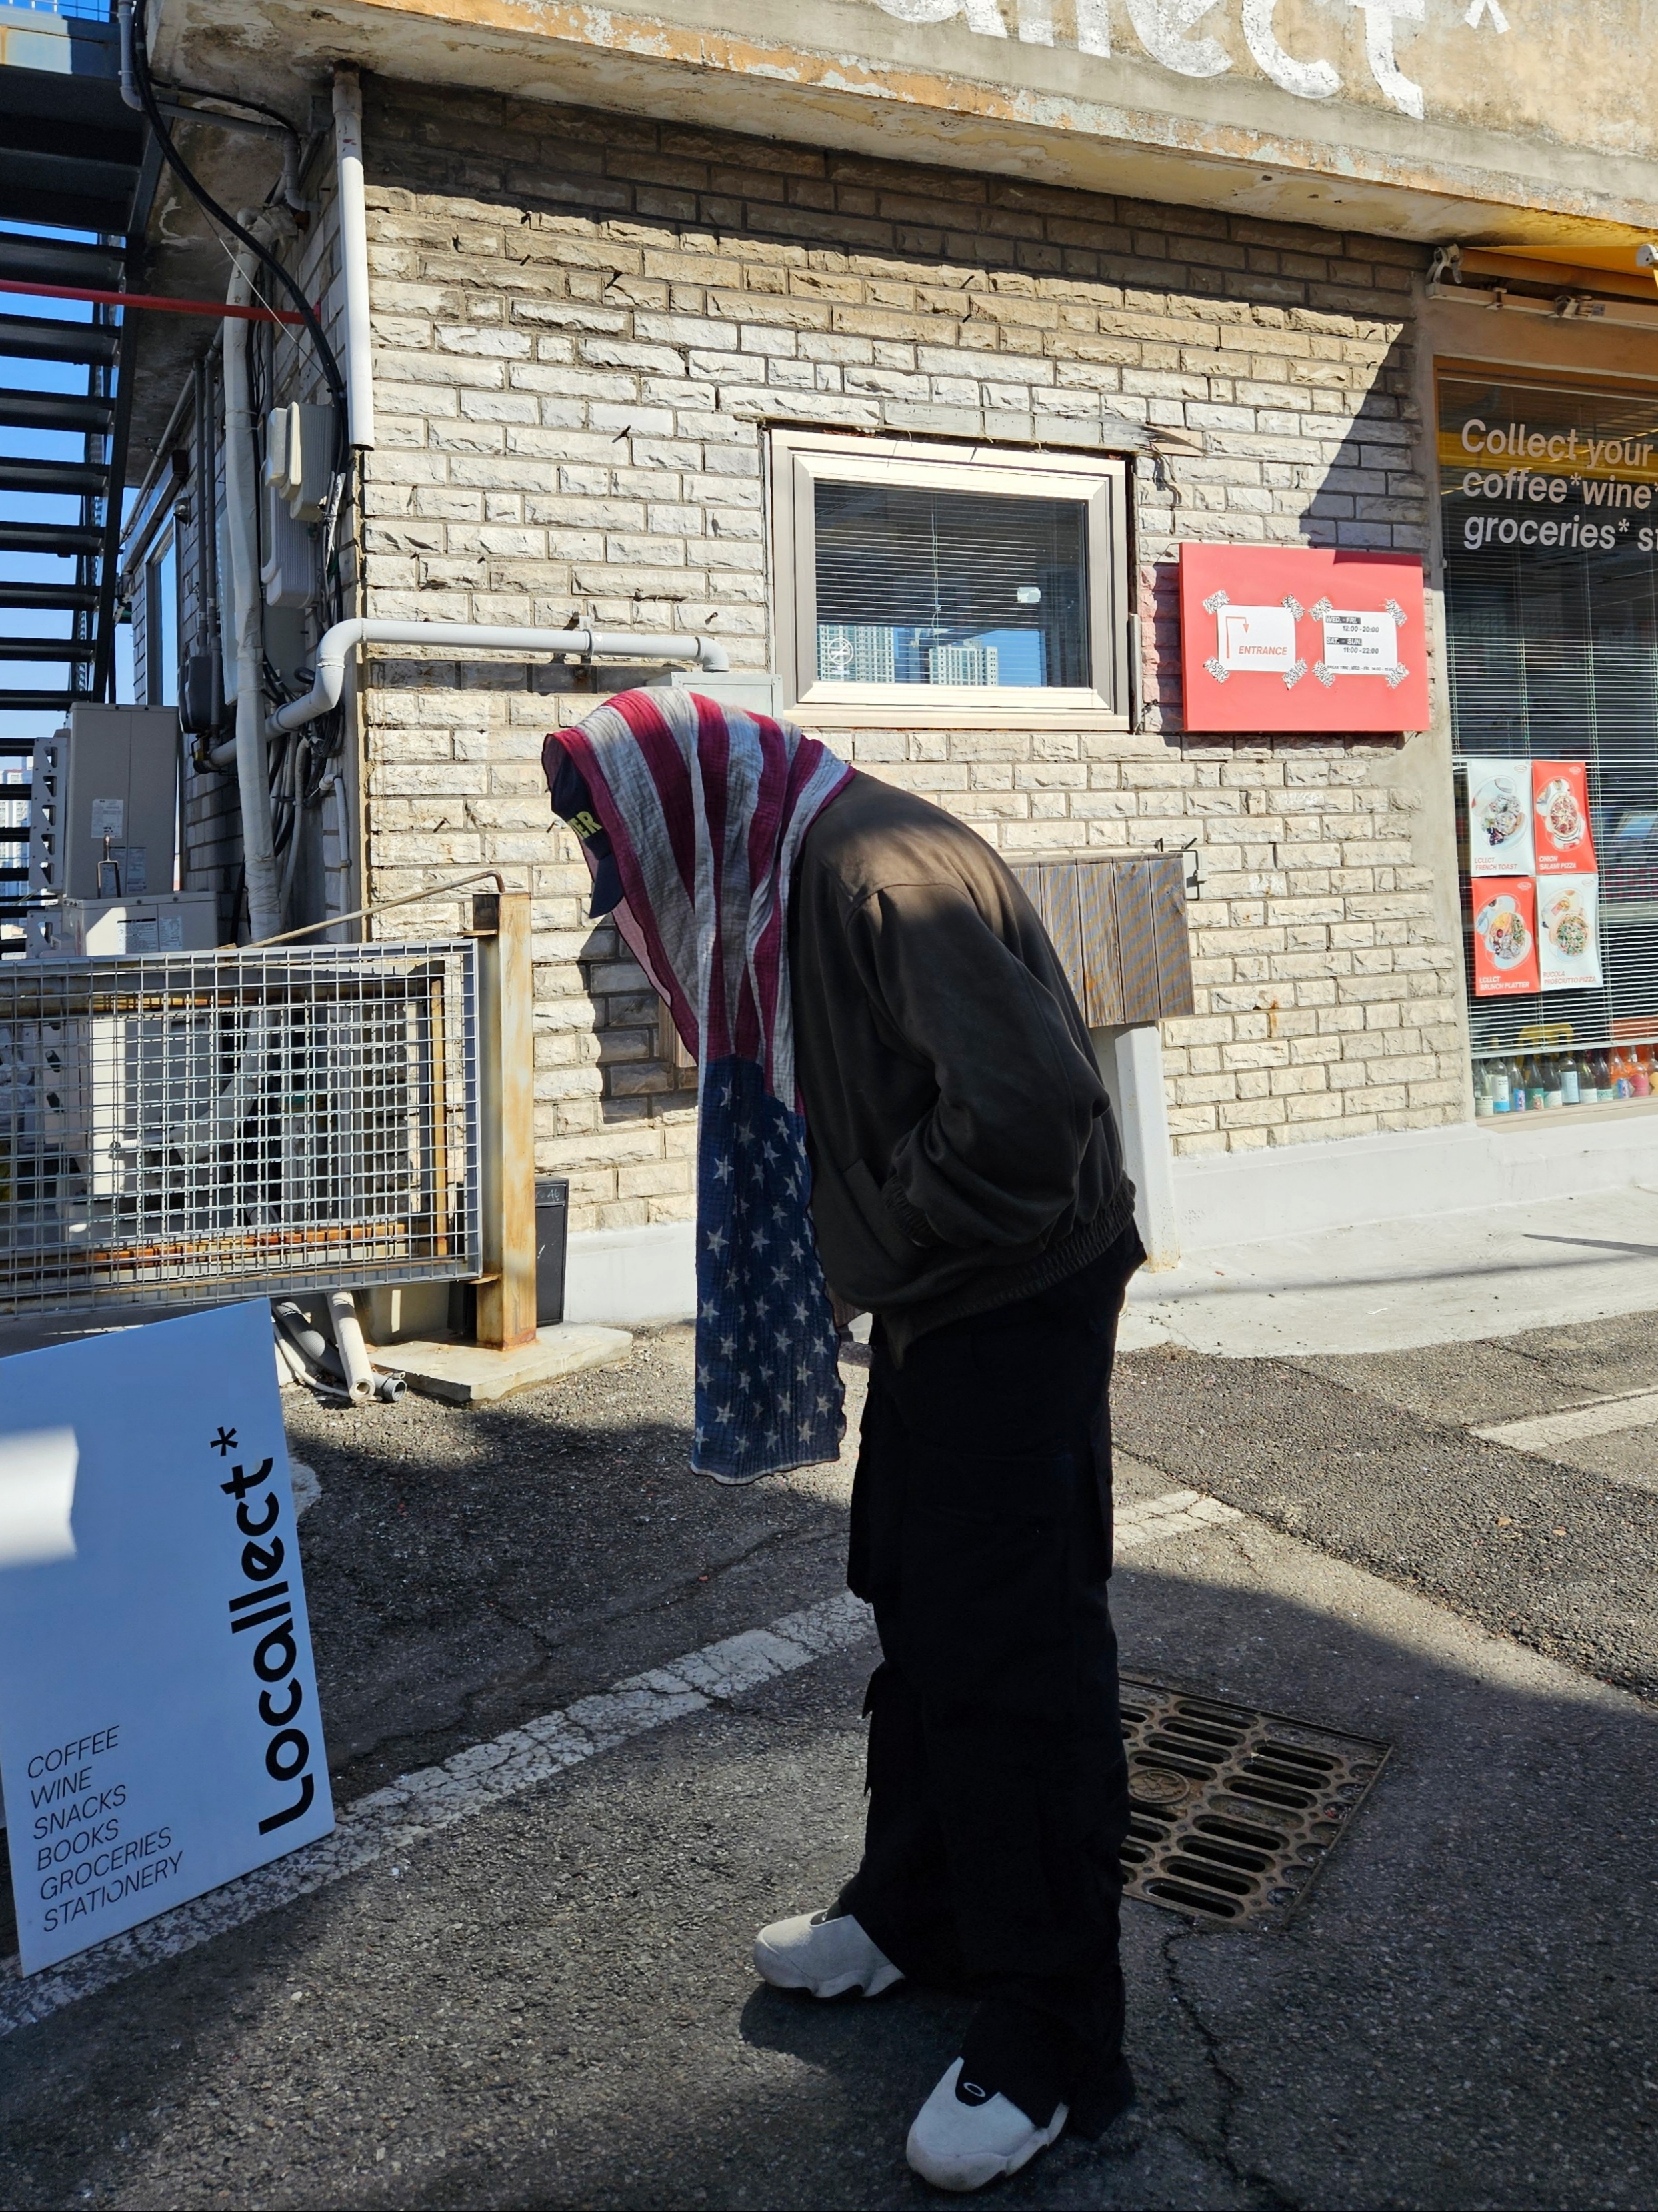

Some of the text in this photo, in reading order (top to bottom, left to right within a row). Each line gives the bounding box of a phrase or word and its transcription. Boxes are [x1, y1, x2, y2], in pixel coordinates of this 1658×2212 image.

[1461, 419, 1653, 470] Collect your
[1637, 526, 1658, 552] s
[1239, 646, 1288, 656] ENTRANCE
[27, 1725, 120, 1779] COFFEE
[30, 1766, 93, 1809] WINE
[33, 1784, 127, 1839] SNACKS
[37, 1819, 119, 1871] BOOKS
[40, 1827, 171, 1900] GROCERIES
[43, 1850, 183, 1932] STATIONERY
